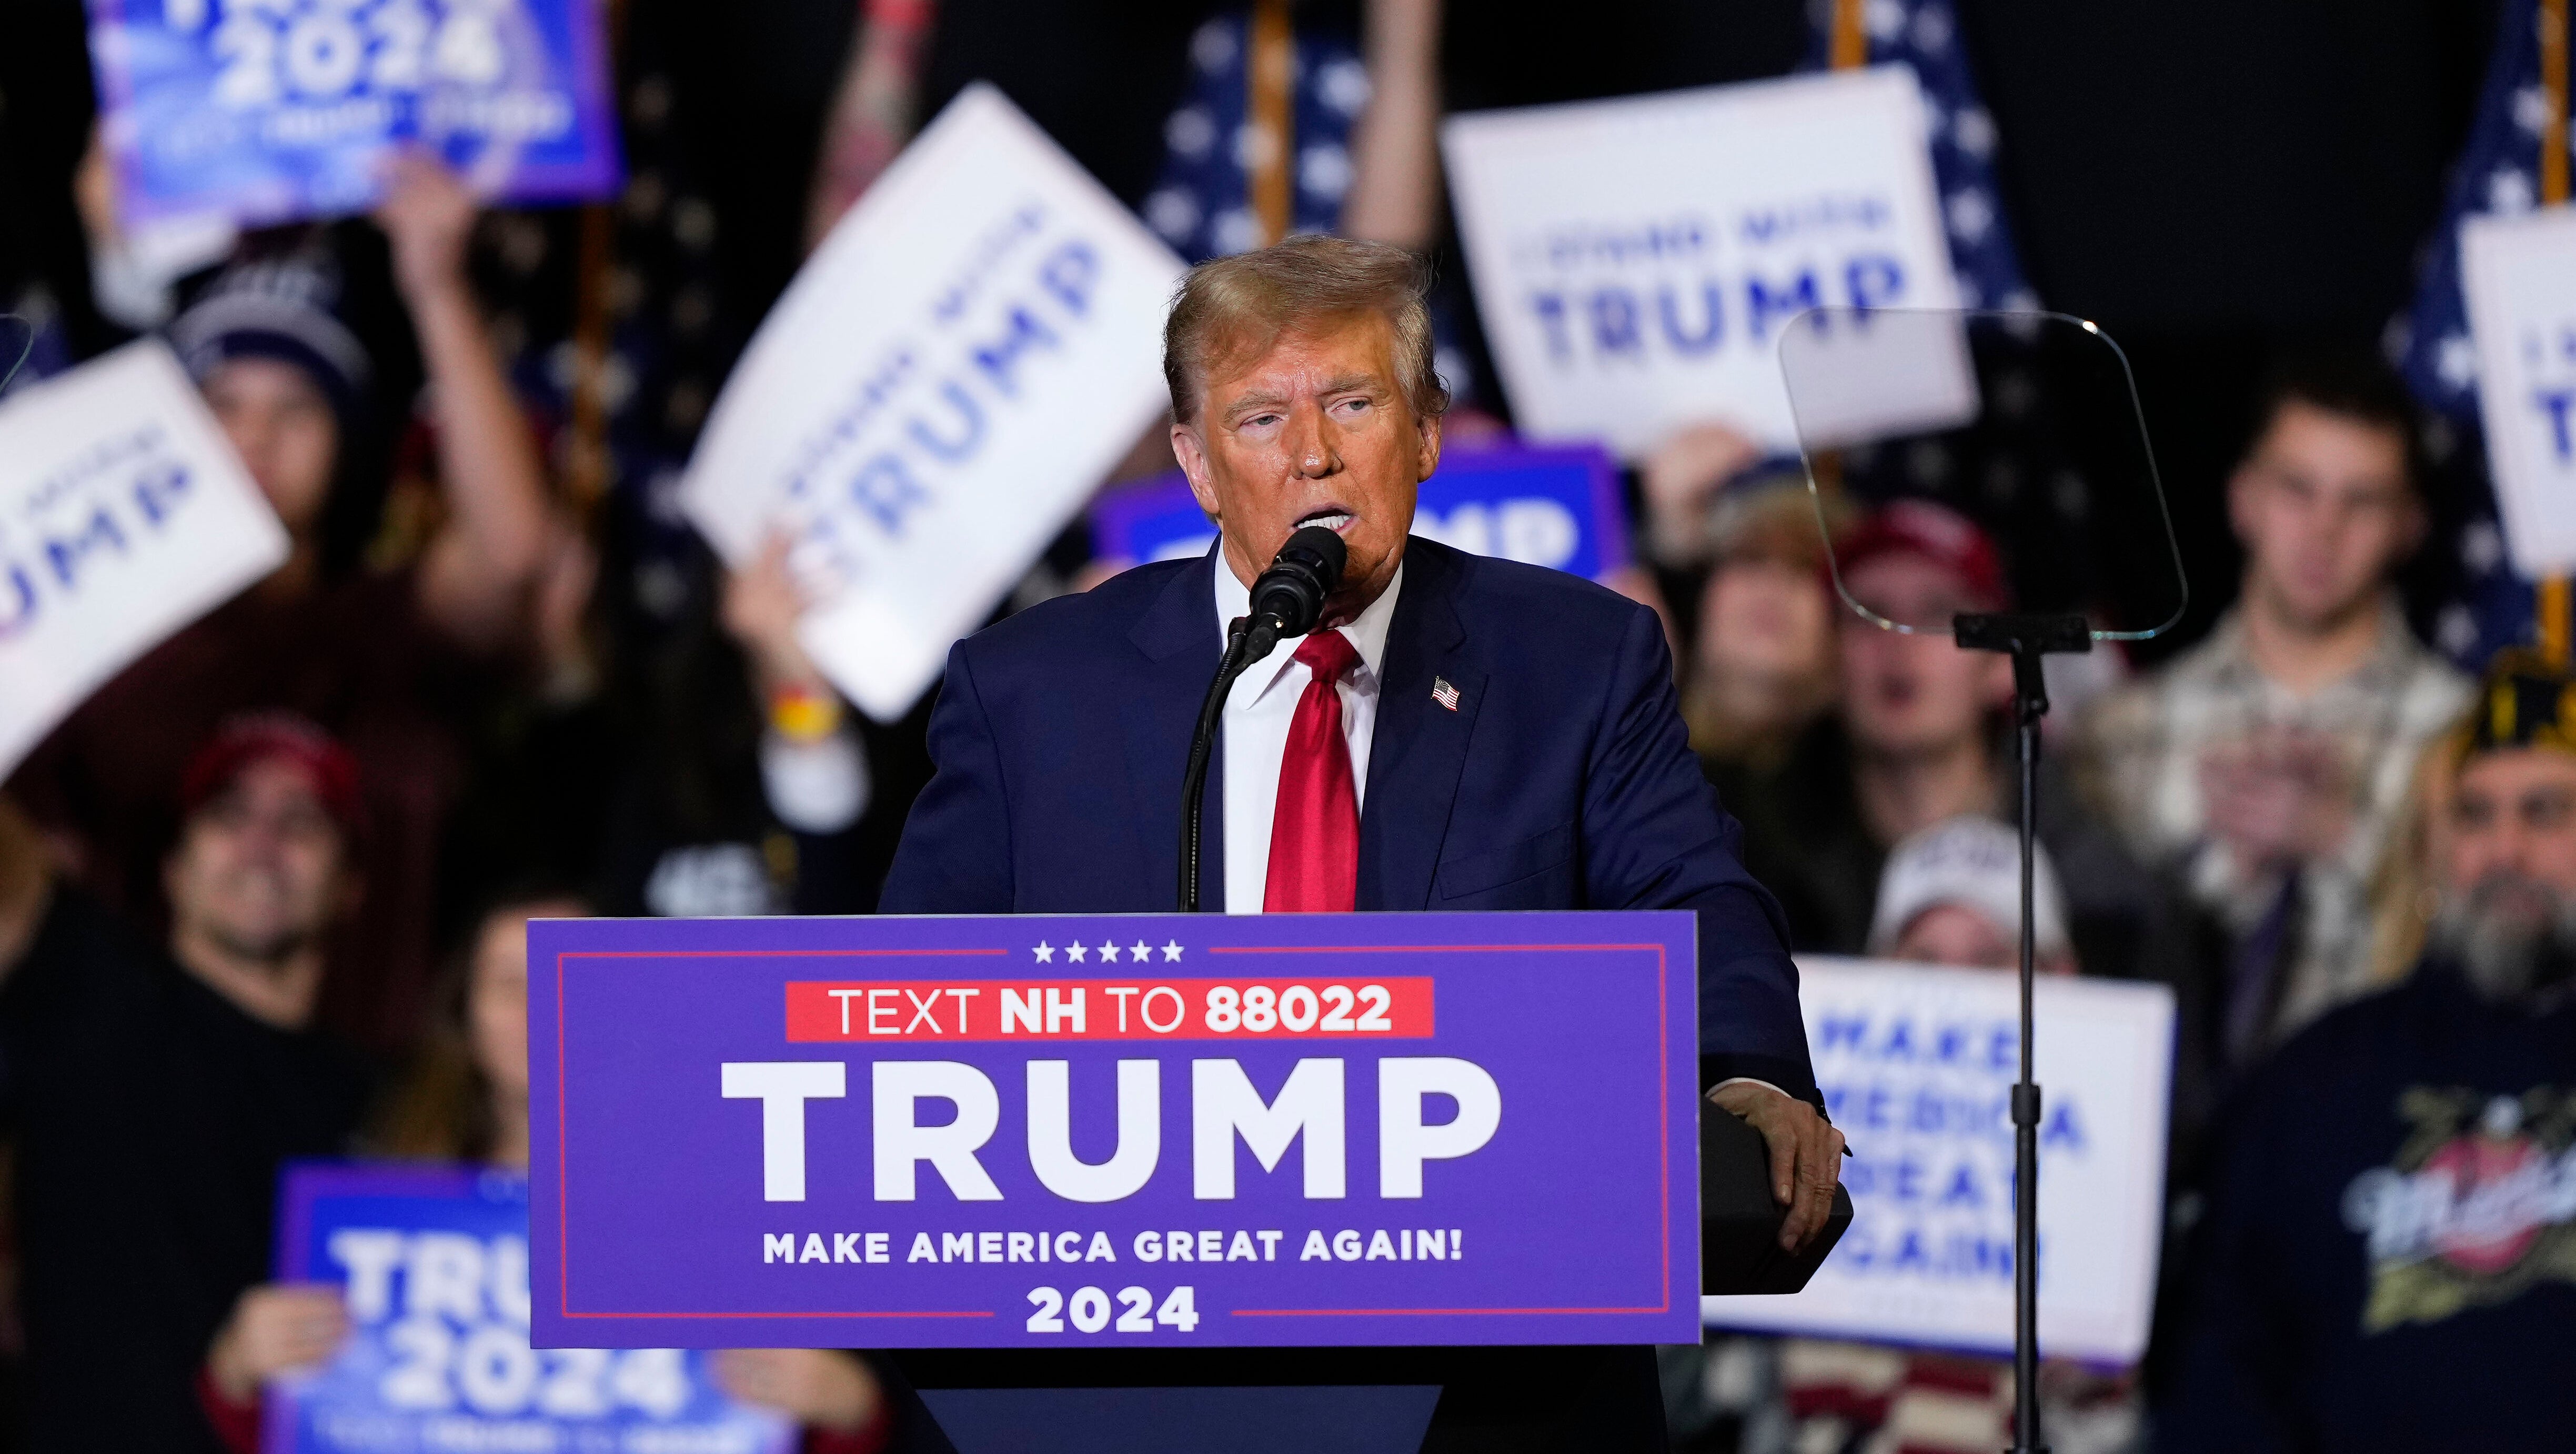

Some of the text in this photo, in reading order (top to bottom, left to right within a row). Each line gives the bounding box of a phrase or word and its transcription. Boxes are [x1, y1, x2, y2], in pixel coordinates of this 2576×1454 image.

[212, 6, 500, 103] 2024
[1527, 250, 1909, 363] TRUMP
[0, 463, 194, 631] UMP
[827, 985, 1392, 1035] TEXT NH TO 88022
[1819, 1016, 2022, 1068] MAKE
[720, 1057, 1502, 1203] TRUMP
[329, 1228, 529, 1323] TRU
[763, 1229, 1462, 1264] MAKE AMERICA GREAT AGAIN!
[1026, 1286, 1200, 1333] 2024
[384, 1318, 689, 1418] 2024
